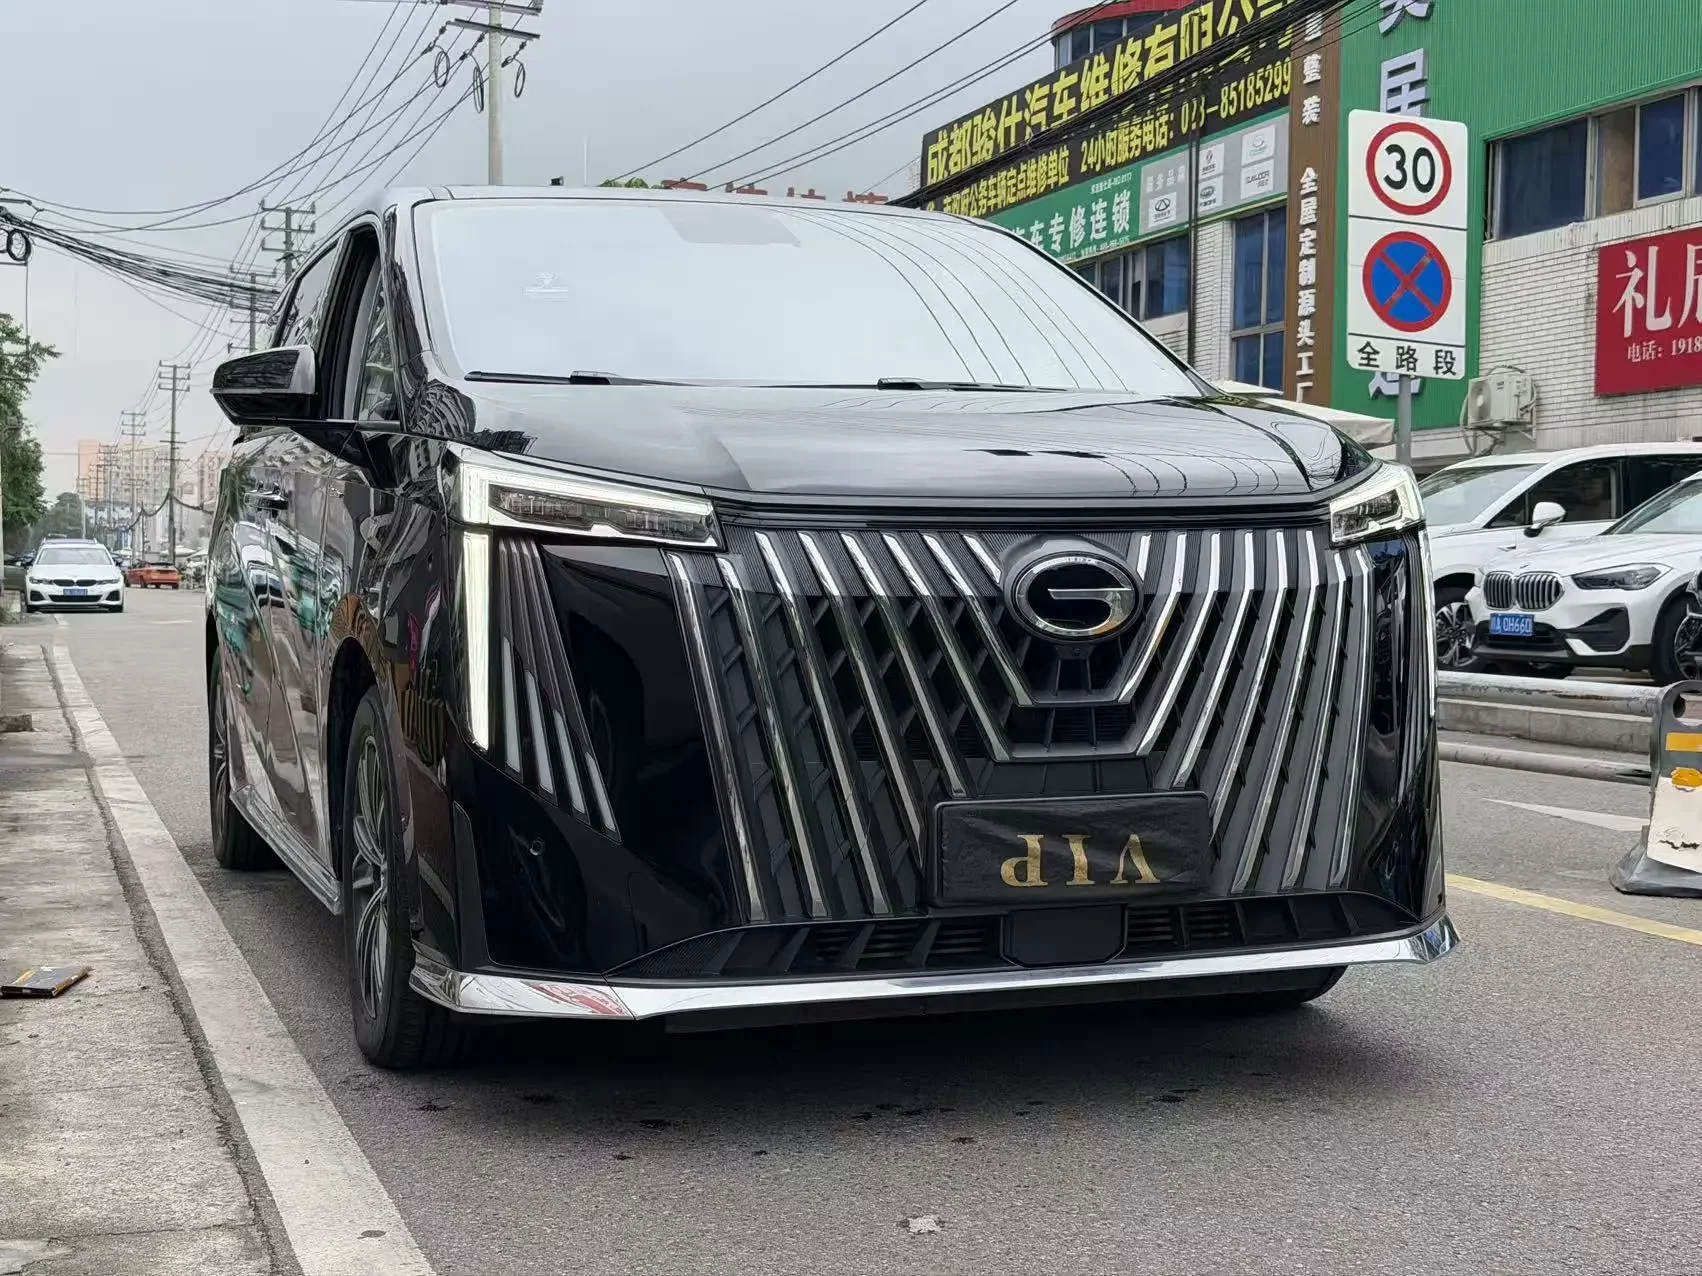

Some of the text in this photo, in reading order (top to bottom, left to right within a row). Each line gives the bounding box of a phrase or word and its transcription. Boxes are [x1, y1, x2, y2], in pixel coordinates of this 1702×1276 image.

[1383, 144, 1435, 193] 30
[1297, 167, 1318, 403] 全屋定制源头工厂
[1357, 341, 1456, 376] 全路段
[1000, 833, 1161, 887] VIP
